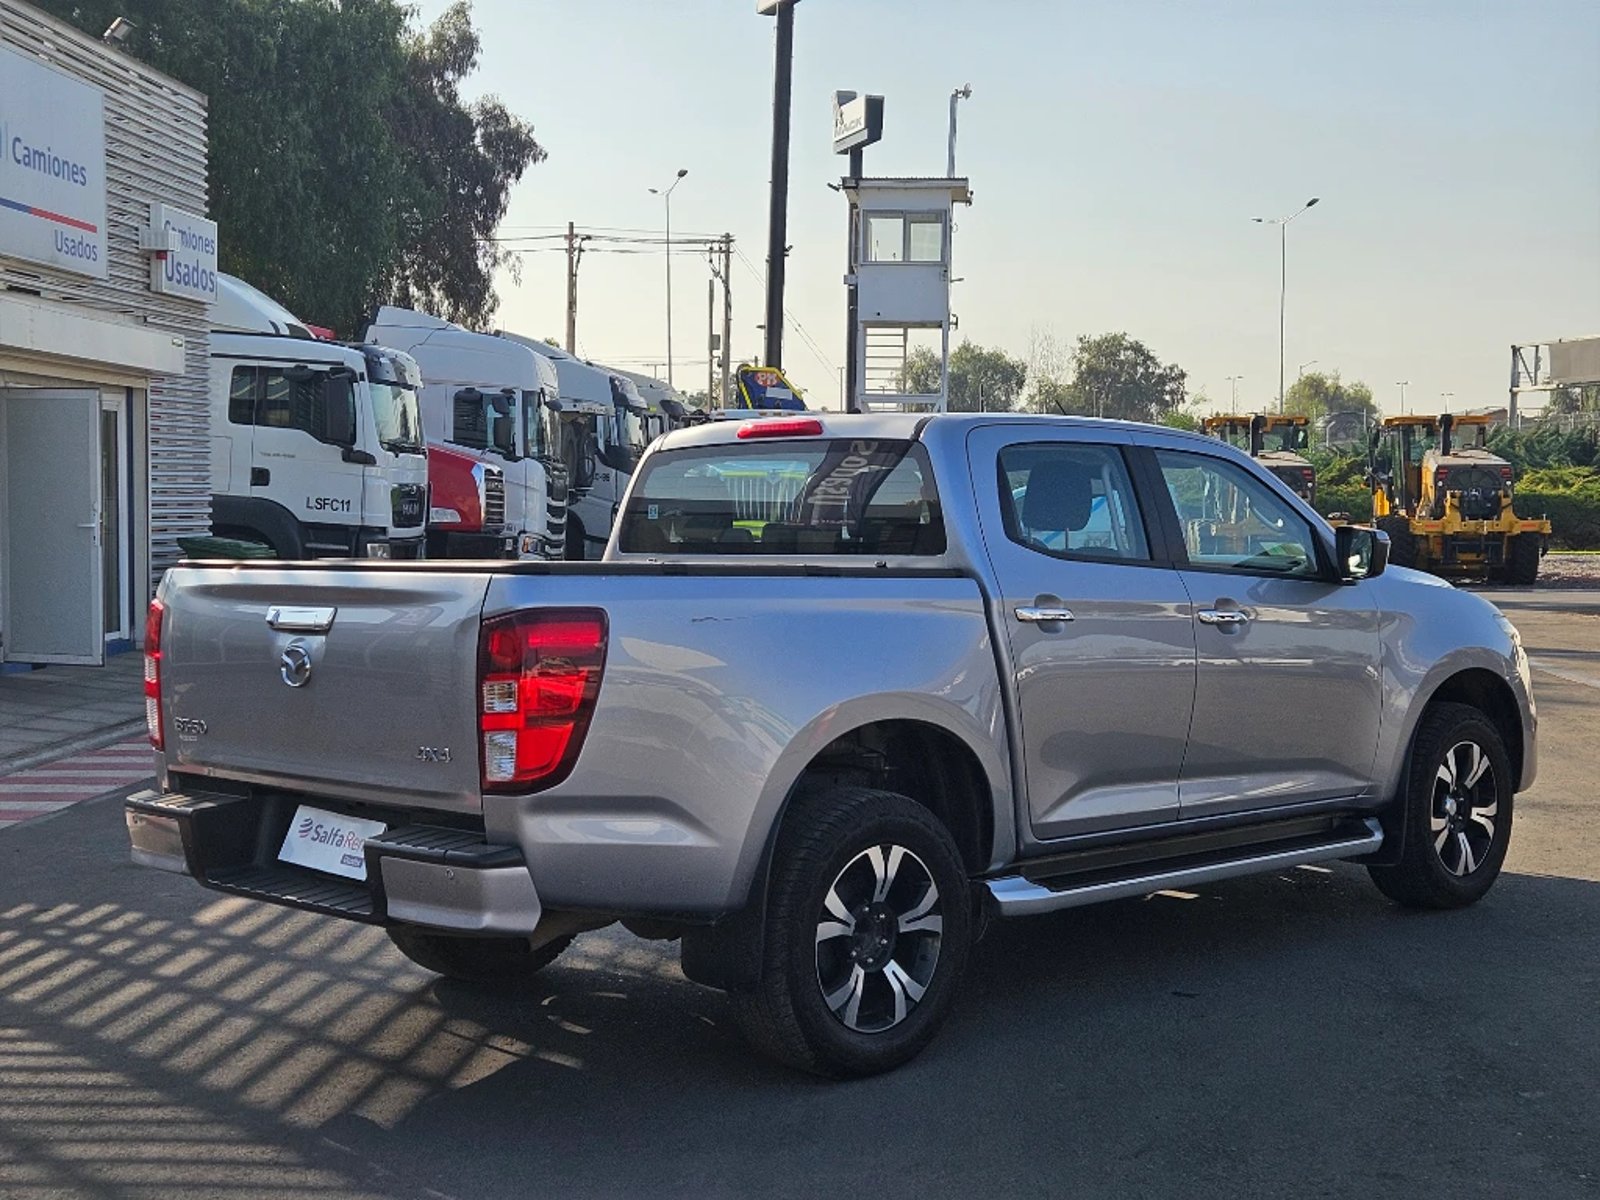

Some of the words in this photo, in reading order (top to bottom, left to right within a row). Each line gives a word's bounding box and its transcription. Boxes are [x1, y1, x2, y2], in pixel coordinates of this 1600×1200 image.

[12, 136, 87, 187] Camiones
[54, 228, 98, 262] Usados
[165, 251, 215, 293] Usados
[305, 496, 351, 512] LSFC11
